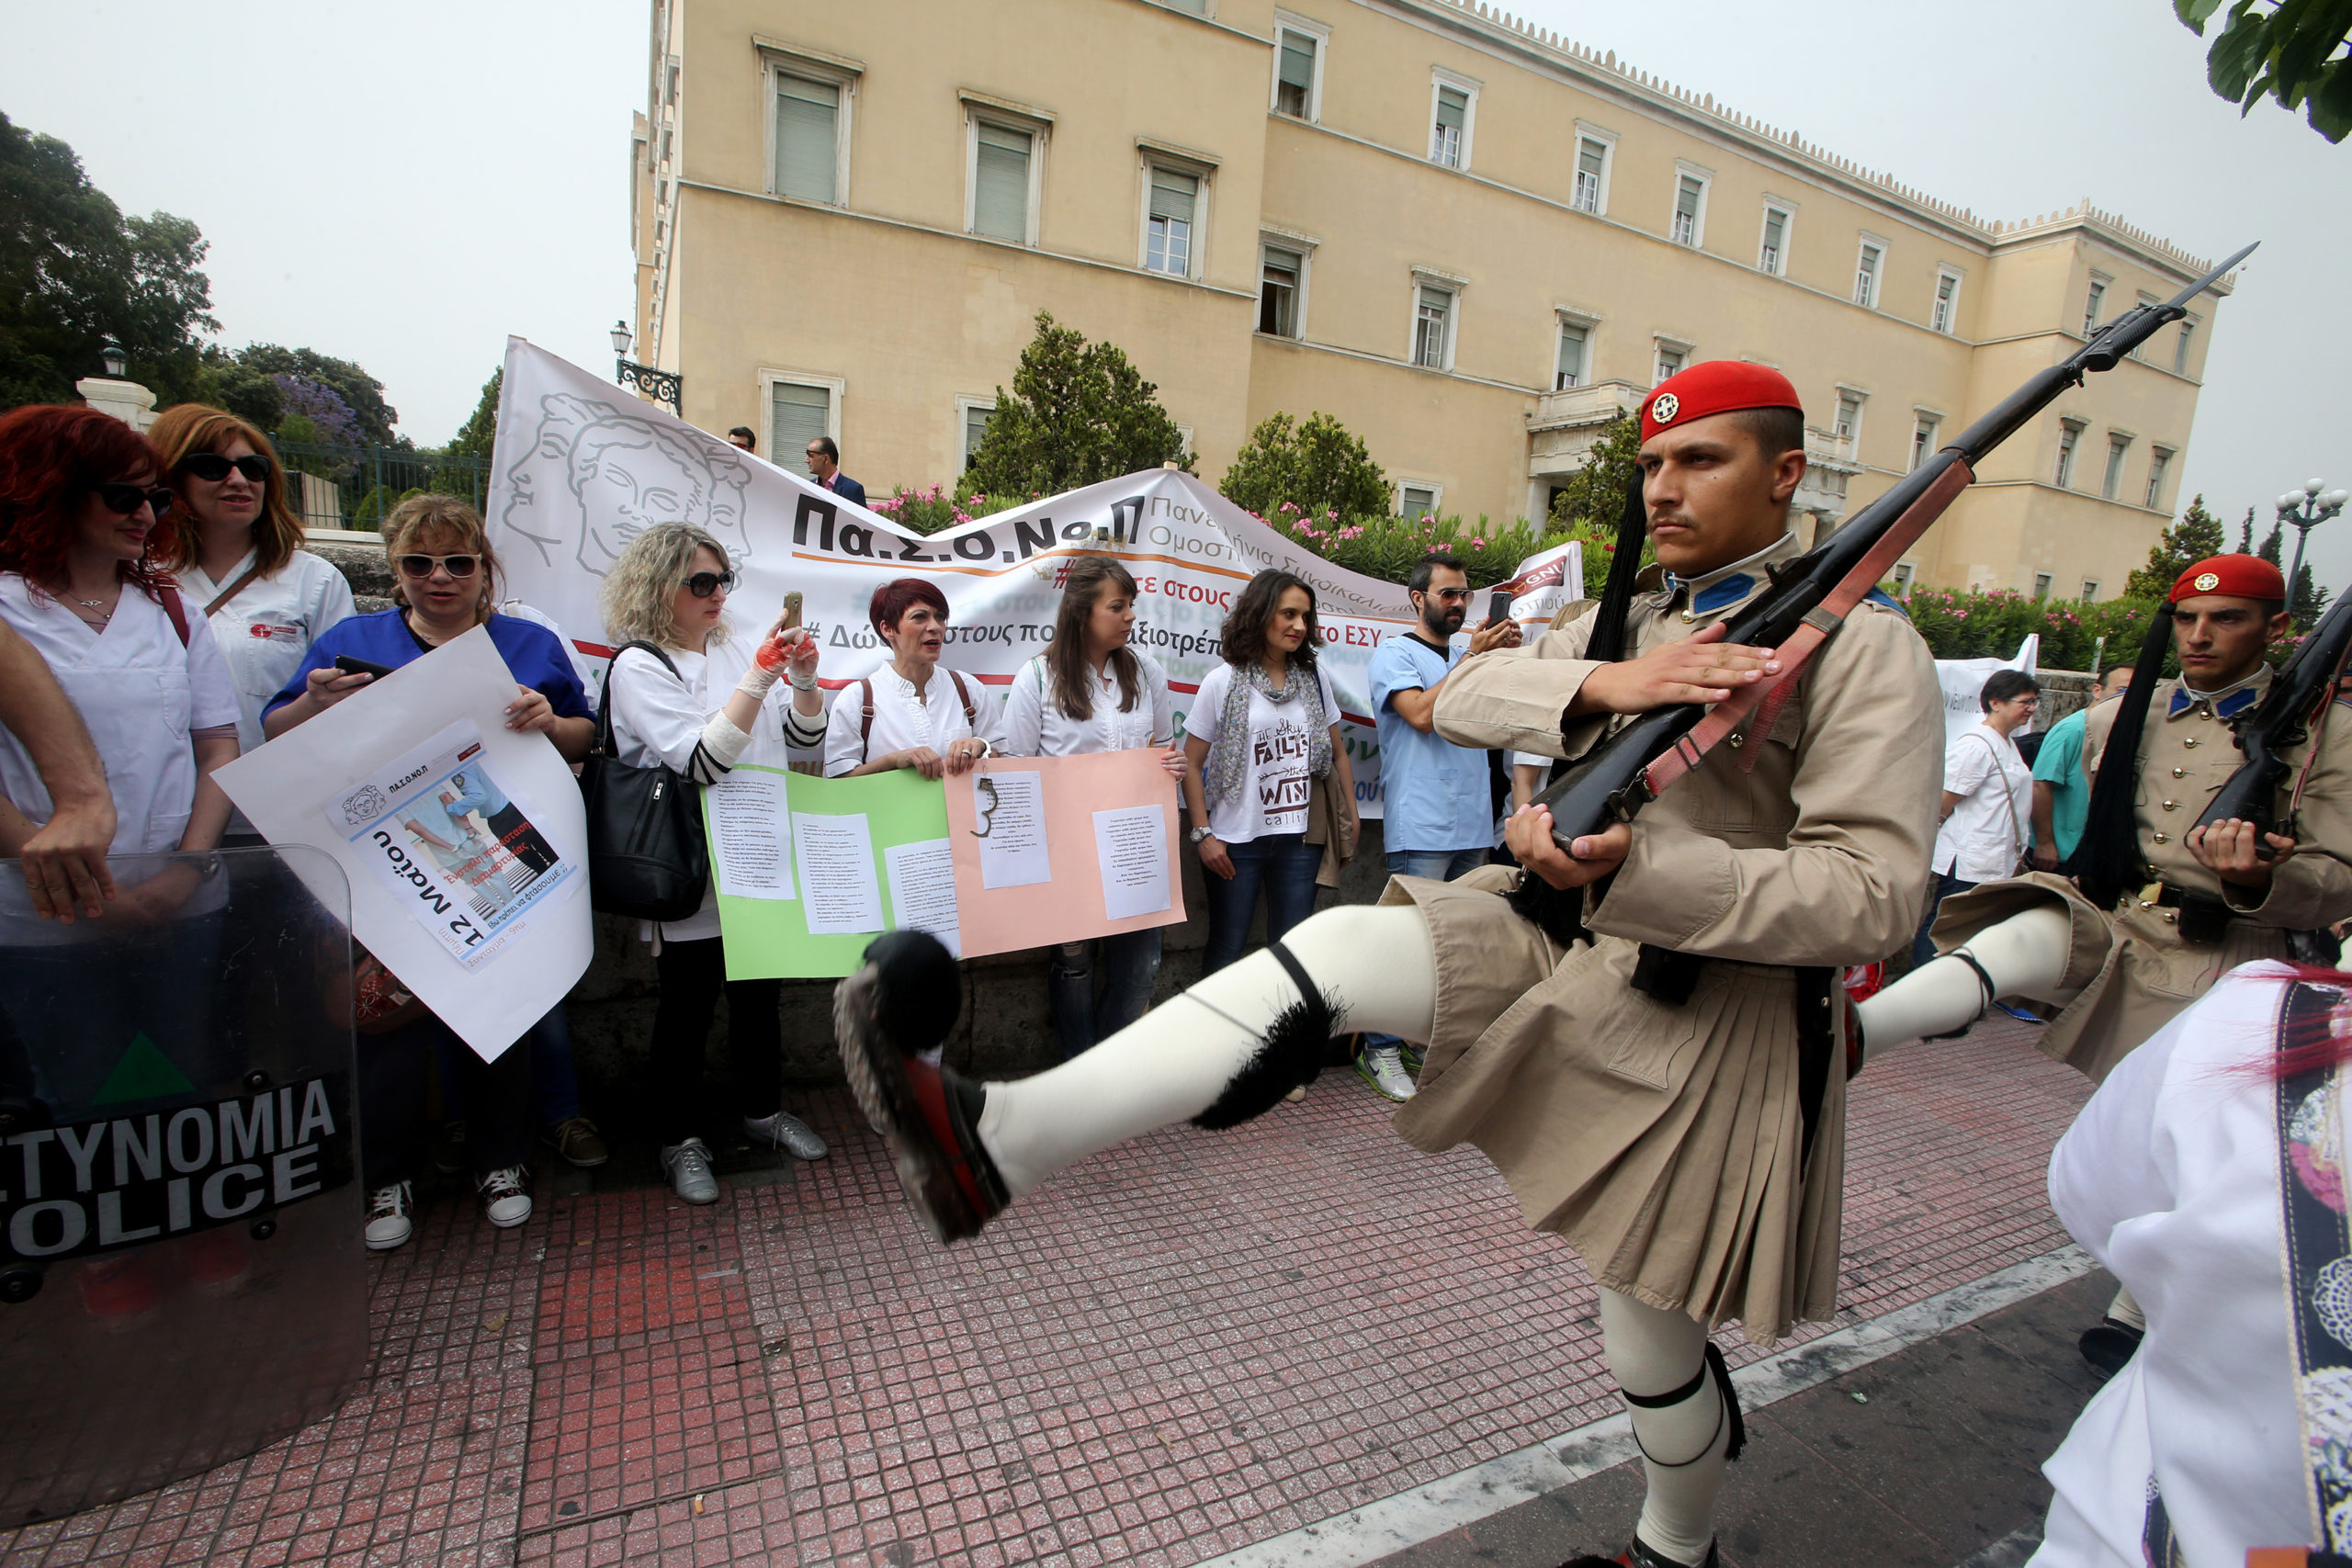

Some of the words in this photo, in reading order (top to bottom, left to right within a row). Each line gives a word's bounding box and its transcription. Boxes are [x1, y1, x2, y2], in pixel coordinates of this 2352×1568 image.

[1150, 496, 1274, 567] Πανελήνια
[1164, 580, 1231, 613] στους
[1345, 624, 1383, 649] ΕΣΥ
[1273, 717, 1304, 740] Sky
[1259, 775, 1309, 806] WIN
[449, 914, 484, 947] 12
[0, 1078, 336, 1202] ΤΥΝΟΜΙΑ
[8, 1143, 322, 1258] OLICE
